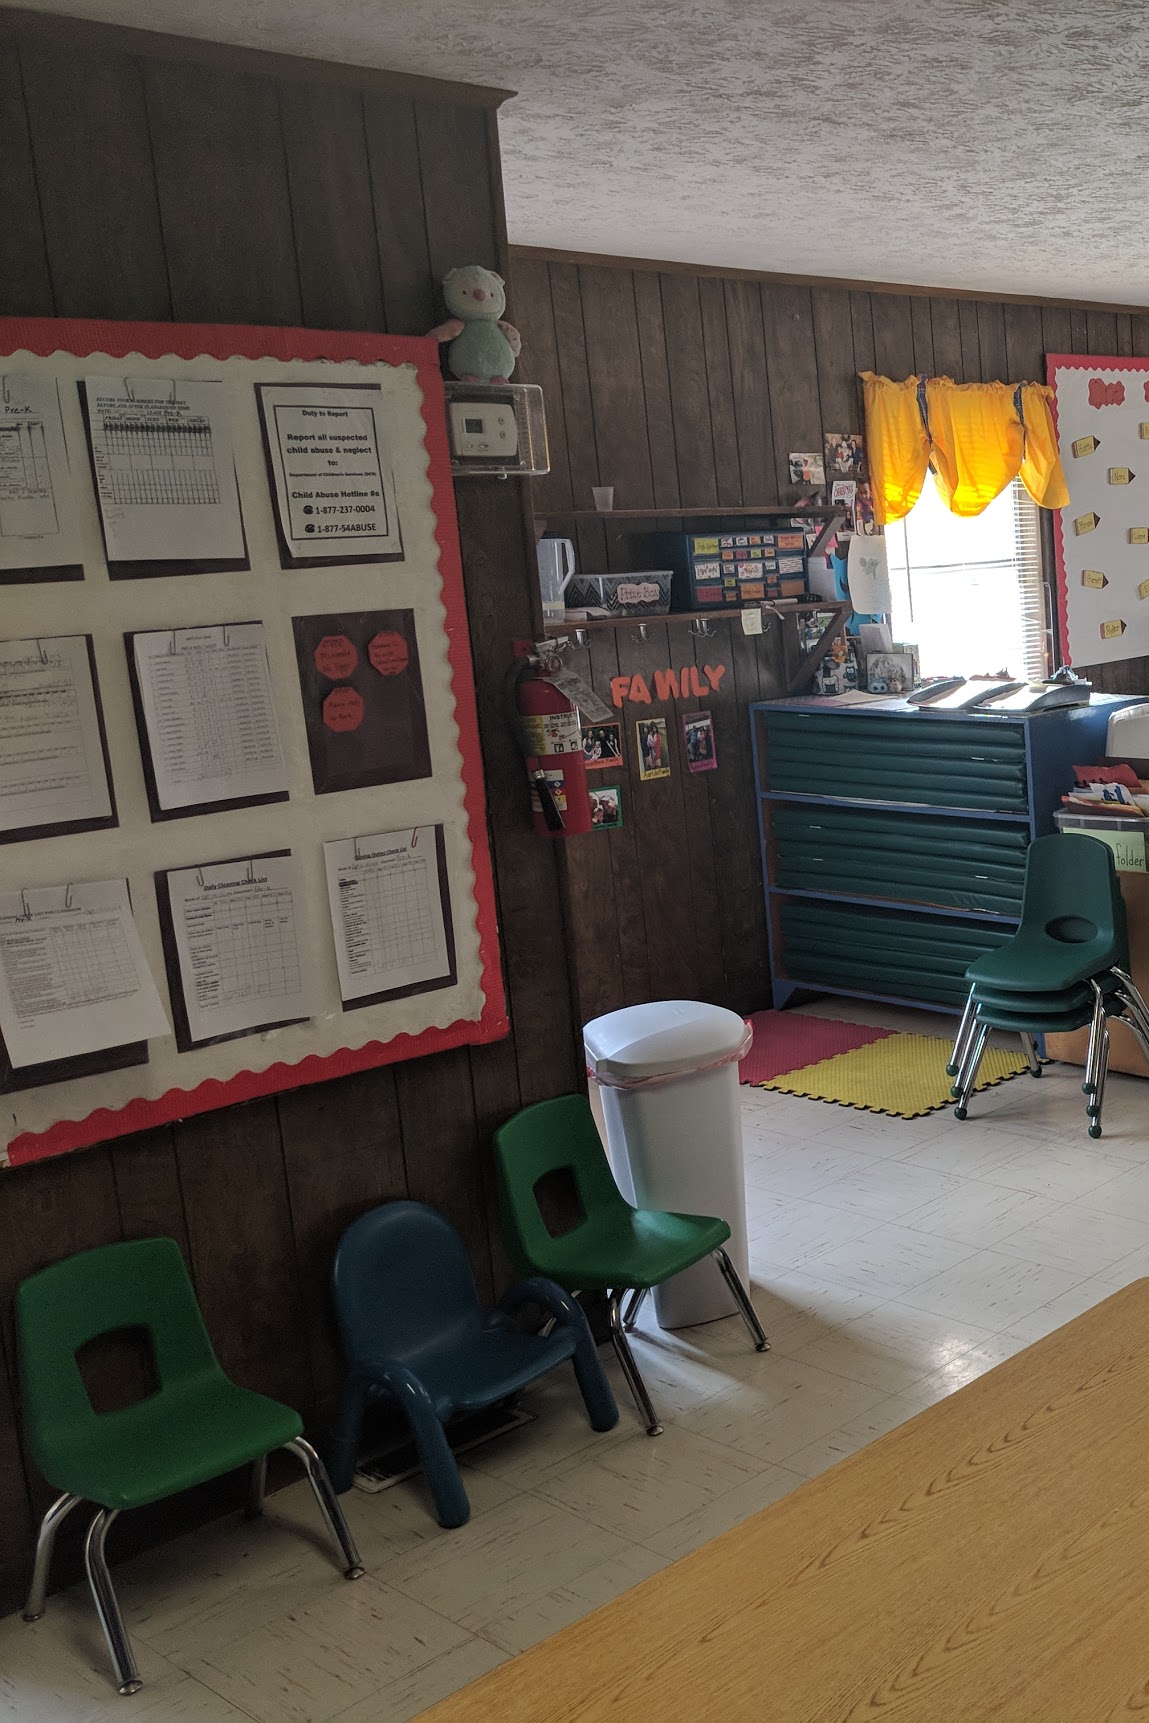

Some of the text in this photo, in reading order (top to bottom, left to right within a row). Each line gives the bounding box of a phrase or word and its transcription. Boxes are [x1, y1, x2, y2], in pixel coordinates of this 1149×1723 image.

[302, 410, 317, 418] Duty
[287, 434, 315, 442] Report
[329, 434, 368, 442] suspected
[344, 447, 372, 455] neglect
[316, 506, 376, 514] 1-877-237-0004
[317, 523, 377, 533] 1-877-54ABUSE
[610, 664, 726, 708] FAMILY
[1116, 842, 1145, 868] folder
[218, 881, 241, 889] Cleaning
